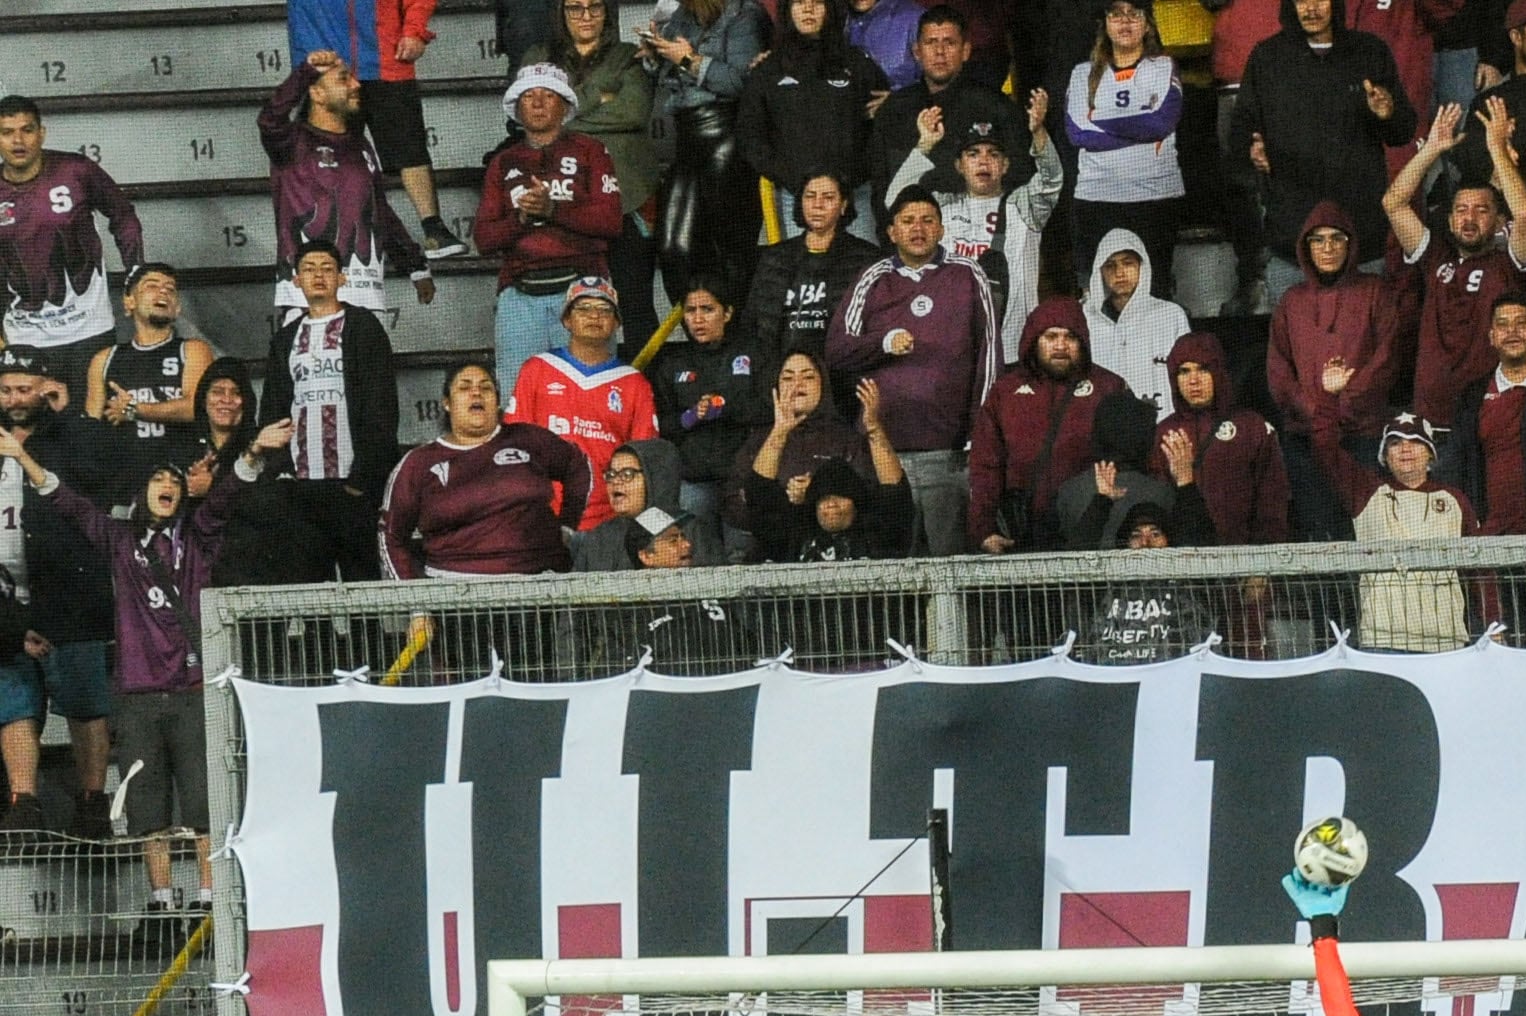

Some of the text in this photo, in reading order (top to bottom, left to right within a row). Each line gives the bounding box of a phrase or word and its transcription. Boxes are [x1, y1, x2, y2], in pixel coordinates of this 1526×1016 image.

[41, 61, 65, 83] 12
[150, 55, 173, 76] 13
[1116, 90, 1130, 108] S
[560, 157, 577, 174] S
[543, 179, 574, 196] AC
[50, 186, 73, 212] S
[223, 226, 248, 248] 15
[1466, 270, 1483, 292] S
[162, 357, 179, 376] S
